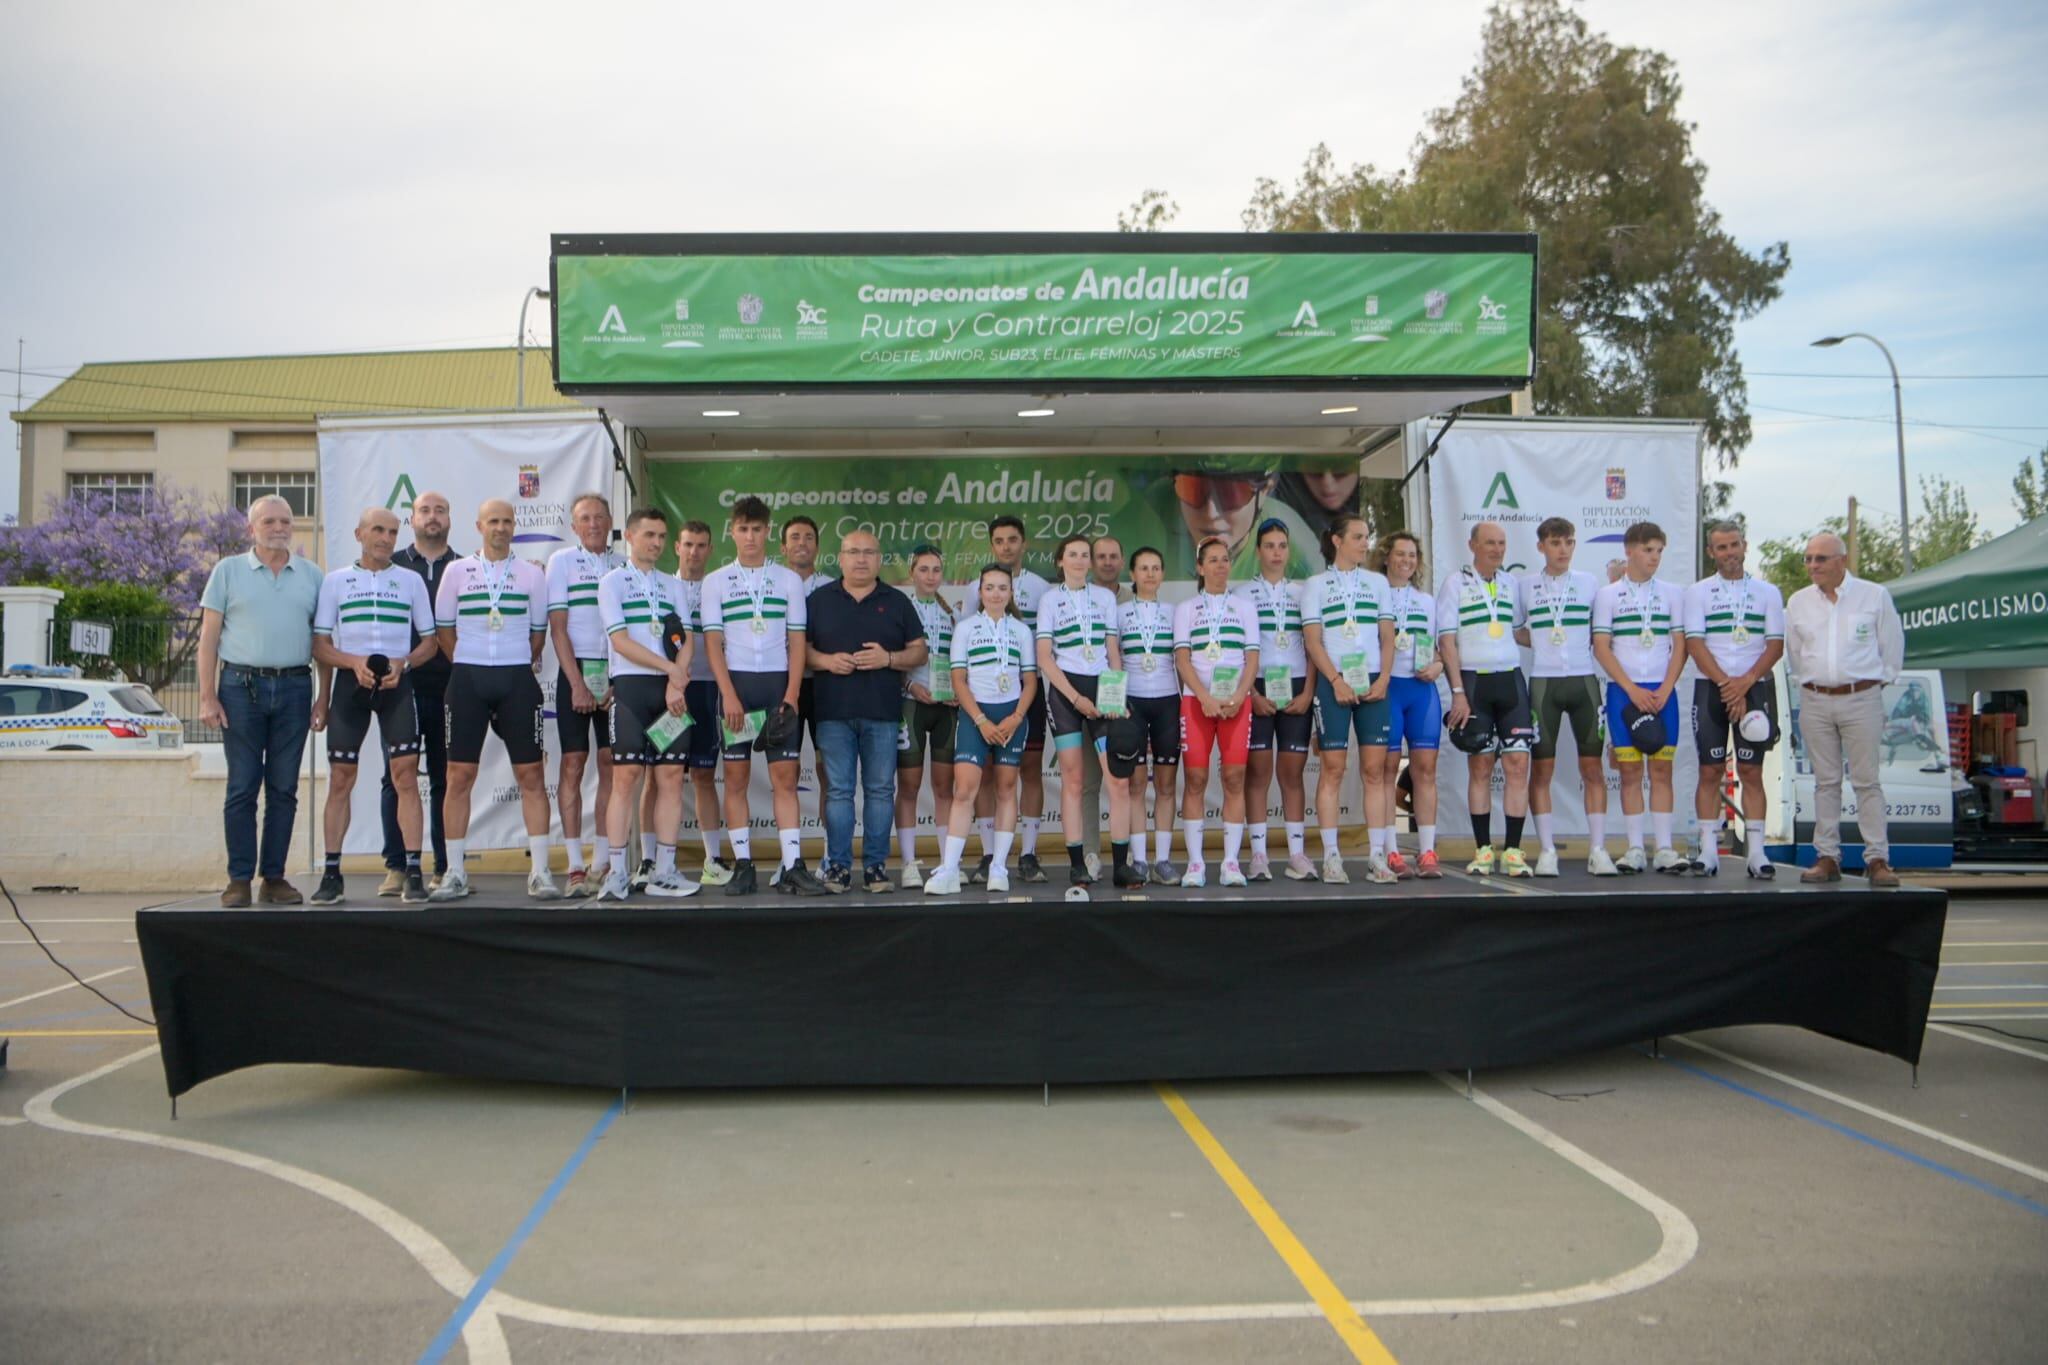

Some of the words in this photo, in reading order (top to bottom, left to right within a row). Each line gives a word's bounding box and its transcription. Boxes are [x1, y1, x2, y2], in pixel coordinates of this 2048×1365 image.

[858, 284, 1028, 307] Campeonatos
[1035, 281, 1065, 301] de
[1071, 266, 1249, 301] Andalucía
[860, 313, 937, 338] Ruta
[942, 318, 966, 343] y
[972, 309, 1163, 341] Contrarreloj
[1169, 310, 1246, 336] 2025
[859, 349, 923, 363] CADETE,
[927, 346, 985, 362] JÚNIOR,
[990, 347, 1039, 361] SUB23,
[1161, 348, 1171, 359] Y
[1172, 344, 1241, 360] MÁSTERS
[897, 487, 928, 505] de
[934, 470, 1115, 504] Andalucía
[514, 503, 565, 516] UTACIÓN
[1582, 505, 1651, 517] DIPUTACIÓN
[1462, 513, 1485, 521] Junta
[1486, 513, 1497, 521] de
[1499, 513, 1543, 522] Andalucía
[1584, 518, 1599, 528] DE
[1034, 513, 1111, 540] 2025
[85, 630, 99, 648] 50
[18, 739, 50, 747] LOCAL
[1895, 804, 1916, 816] 237
[1920, 804, 1941, 816] 753
